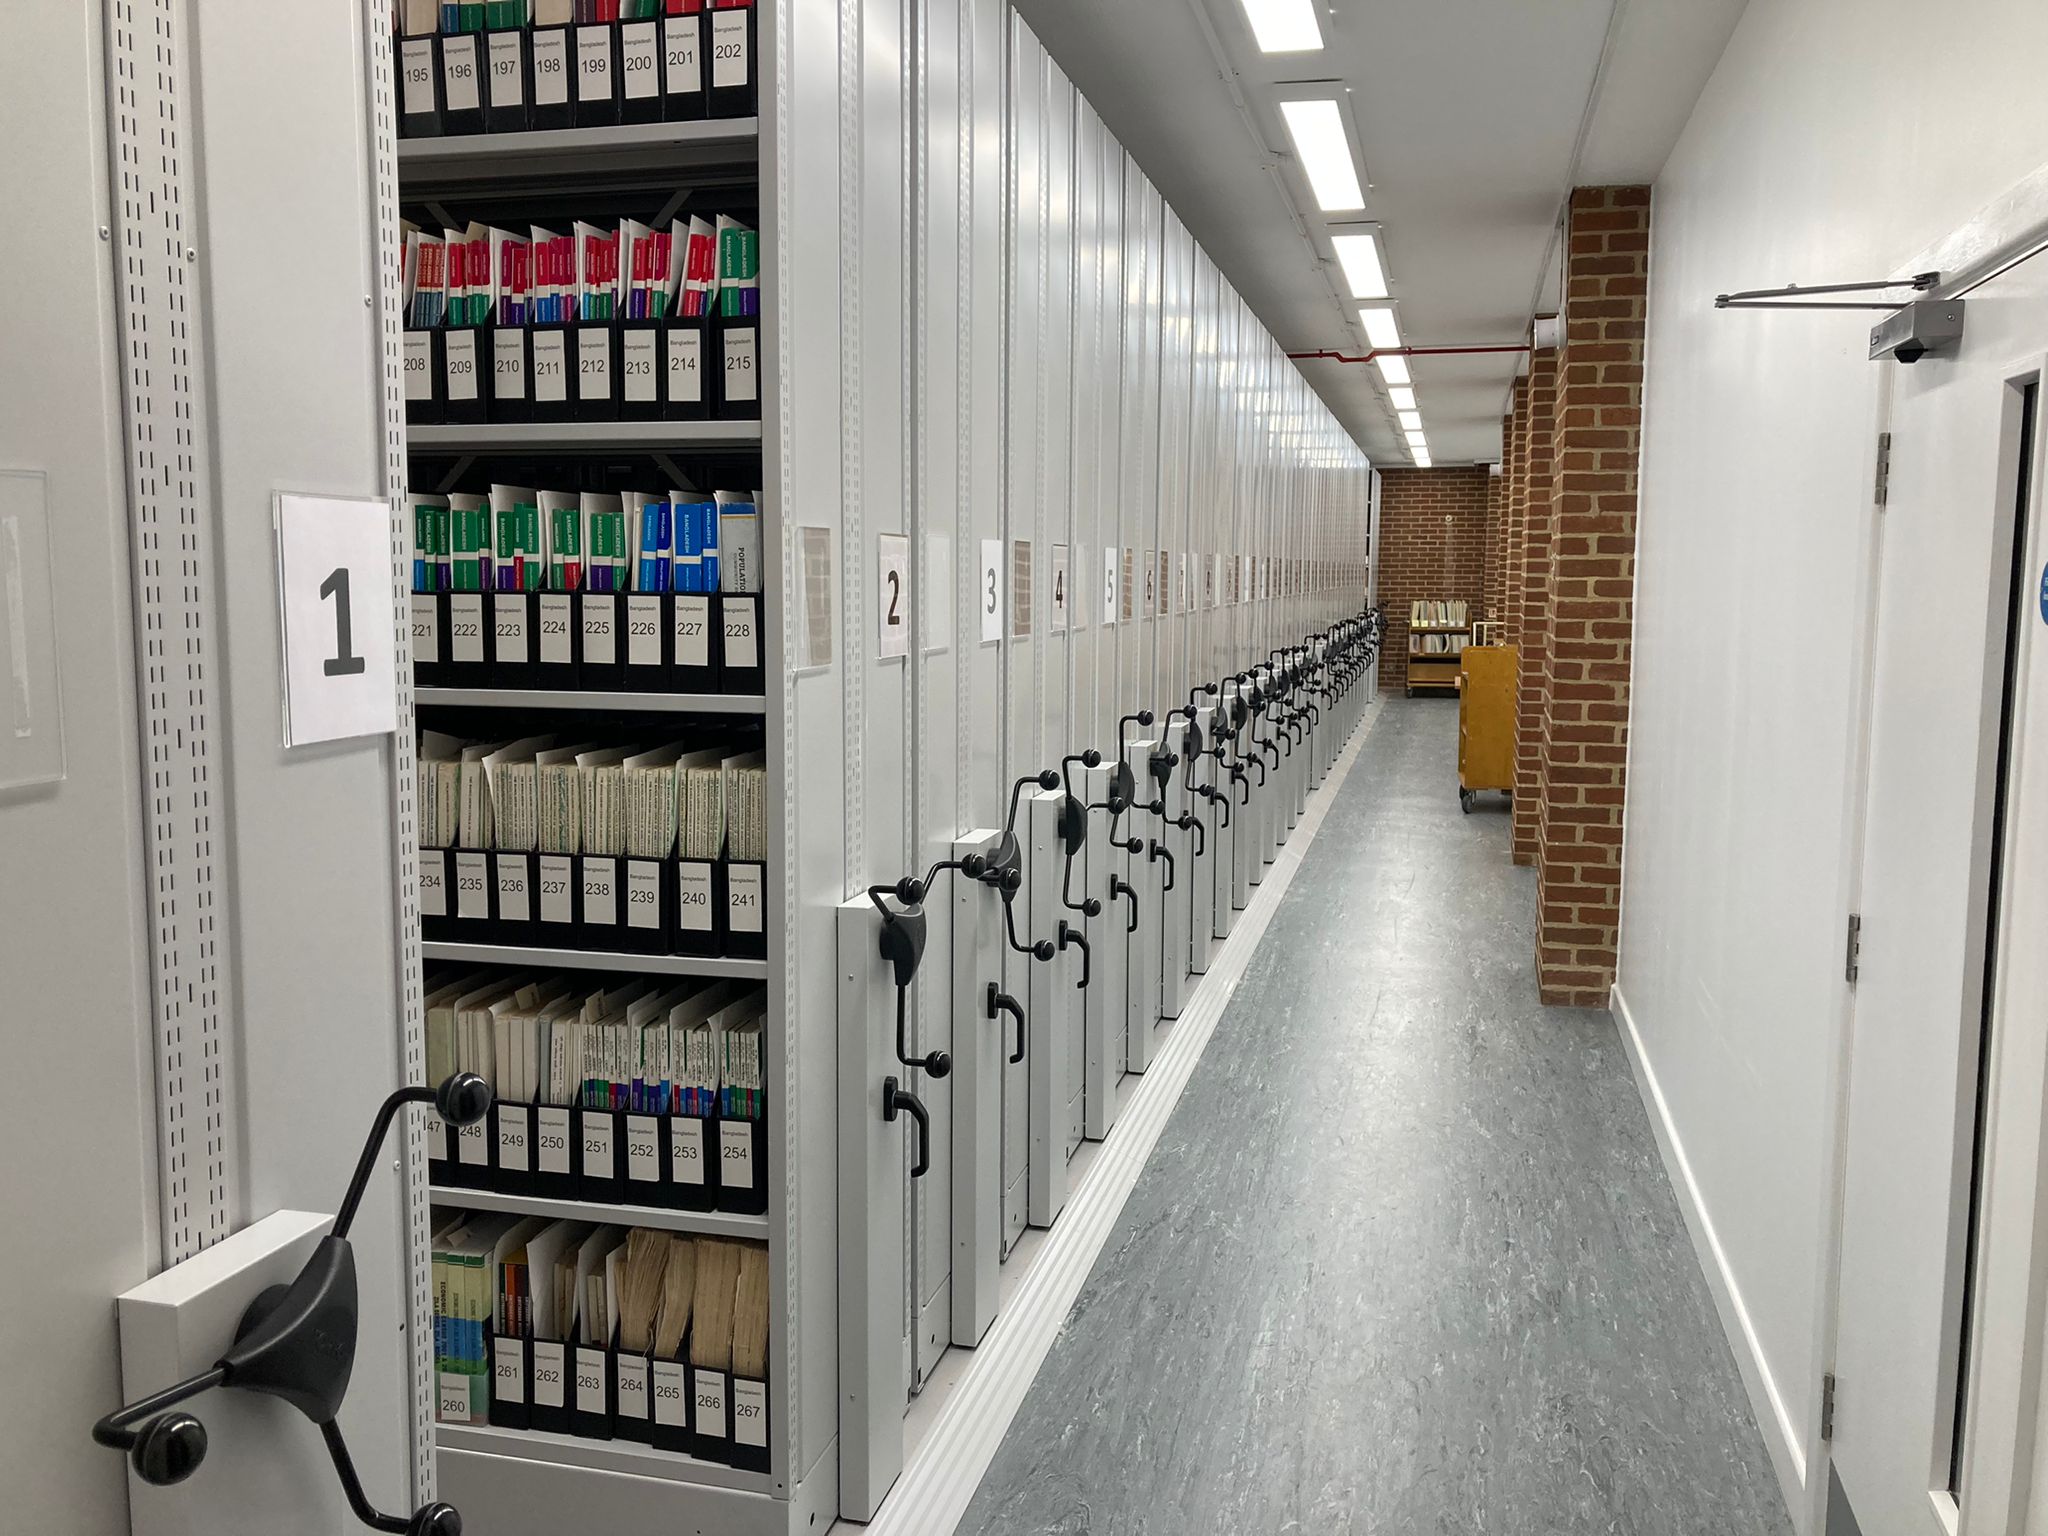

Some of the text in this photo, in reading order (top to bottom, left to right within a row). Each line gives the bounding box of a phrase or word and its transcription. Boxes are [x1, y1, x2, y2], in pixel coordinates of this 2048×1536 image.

[667, 32, 694, 41] Bangladesh
[444, 47, 472, 55] Bangladesh
[533, 40, 559, 49] Bangladesh
[579, 41, 606, 49] Bangladesh
[669, 51, 692, 65] 201
[716, 44, 741, 59] 202
[494, 61, 515, 74] 197
[537, 58, 560, 72] 198
[582, 59, 605, 73] 199
[626, 56, 651, 71] 200
[407, 68, 428, 82] 195
[449, 64, 471, 78] 196
[404, 358, 425, 370] 208
[450, 361, 471, 374] 209
[497, 360, 519, 372] 210
[537, 362, 558, 375] 211
[582, 360, 604, 372] 212
[626, 362, 649, 374] 213
[672, 358, 695, 370] 214
[727, 356, 750, 370] 215
[738, 547, 746, 592] POPULATIO
[987, 567, 996, 614] 3
[1056, 570, 1063, 608] 4
[1108, 569, 1113, 603] 5
[1147, 570, 1152, 601] 6
[888, 570, 900, 625] 2
[320, 567, 365, 677] 1
[543, 621, 565, 633] 224
[585, 621, 609, 634] 225
[631, 622, 655, 635] 226
[412, 624, 430, 636] 221
[454, 624, 477, 636] 222
[497, 624, 520, 636] 223
[678, 623, 702, 635] 227
[726, 624, 749, 637] 228
[420, 875, 440, 887] 234
[460, 878, 482, 890] 235
[501, 880, 523, 892] 236
[543, 881, 565, 893] 237
[586, 883, 609, 895] 238
[631, 890, 654, 903] 239
[683, 892, 706, 905] 240
[732, 894, 754, 906] 241
[427, 1121, 440, 1132] 47
[459, 1125, 481, 1137] 248
[502, 1134, 523, 1146] 249
[541, 1136, 564, 1149] 250
[586, 1140, 606, 1153] 251
[631, 1144, 653, 1157] 252
[674, 1146, 697, 1159] 253
[724, 1146, 747, 1159] 254
[498, 1365, 517, 1378] 261
[537, 1369, 558, 1382] 262
[578, 1376, 599, 1389] 263
[621, 1378, 642, 1391] 264
[657, 1386, 679, 1399] 265
[443, 1400, 465, 1412] 260
[698, 1395, 720, 1409] 266
[737, 1404, 760, 1417] 267
